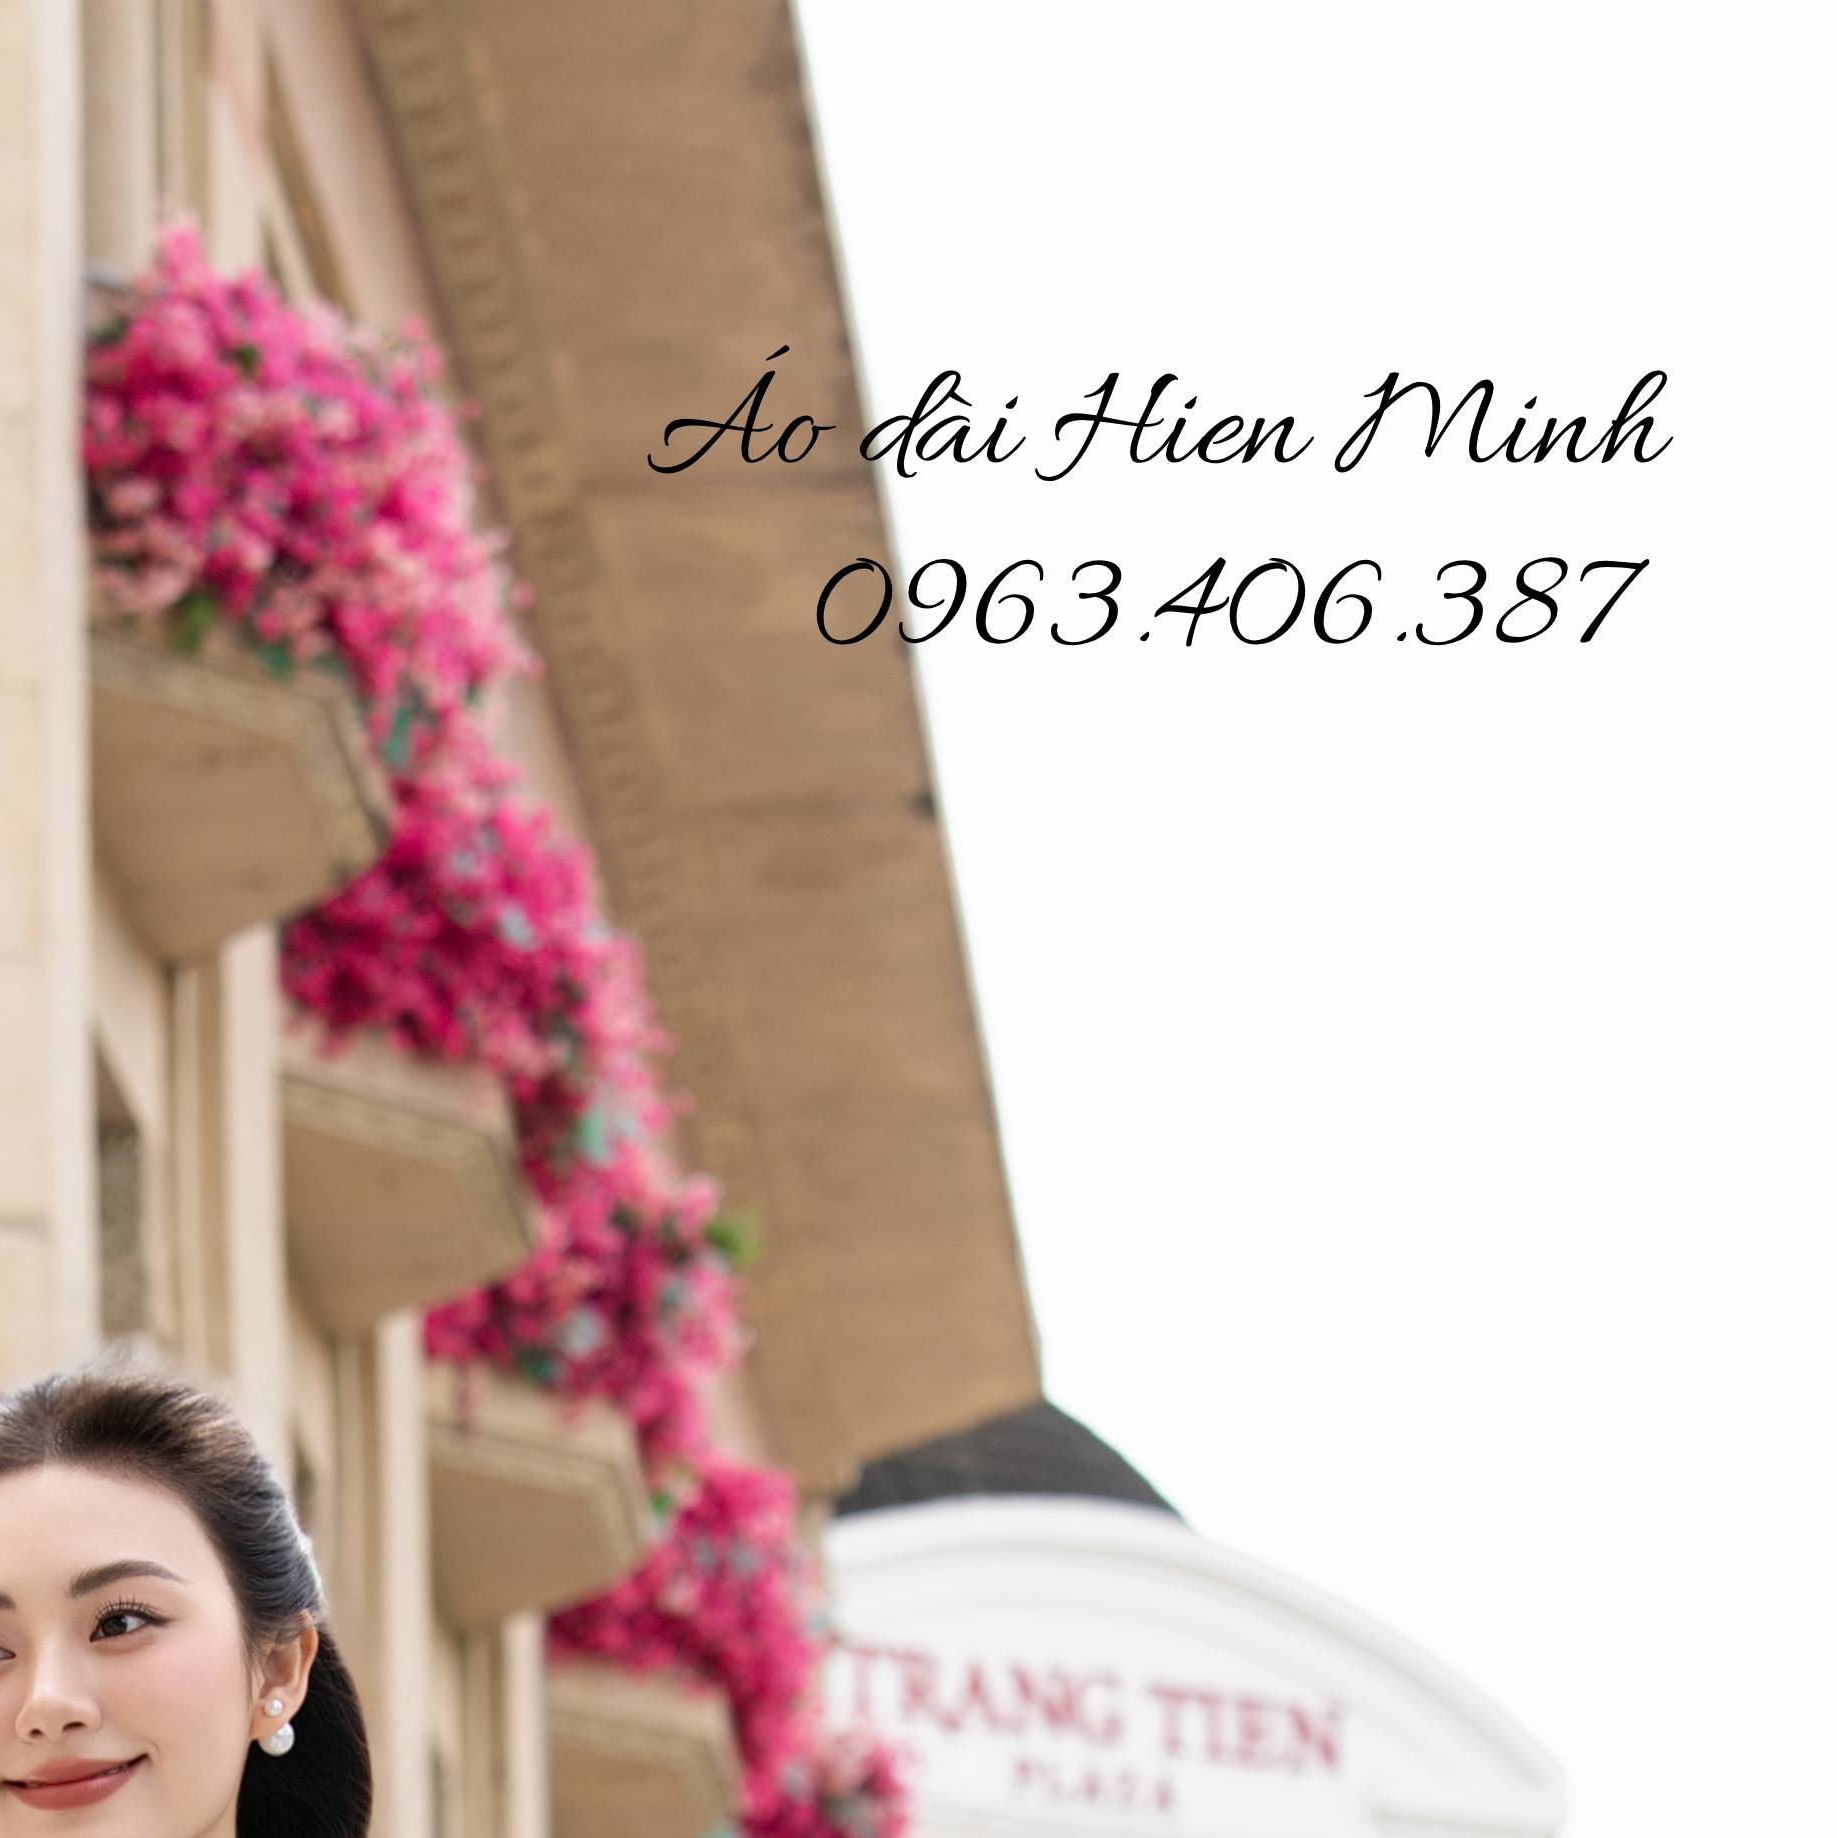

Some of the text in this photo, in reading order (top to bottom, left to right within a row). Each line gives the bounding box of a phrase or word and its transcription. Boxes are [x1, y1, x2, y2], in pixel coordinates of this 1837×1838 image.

[834, 1645, 1345, 1771] TRANG TIEN
[1015, 1755, 1175, 1812] PLAZA
